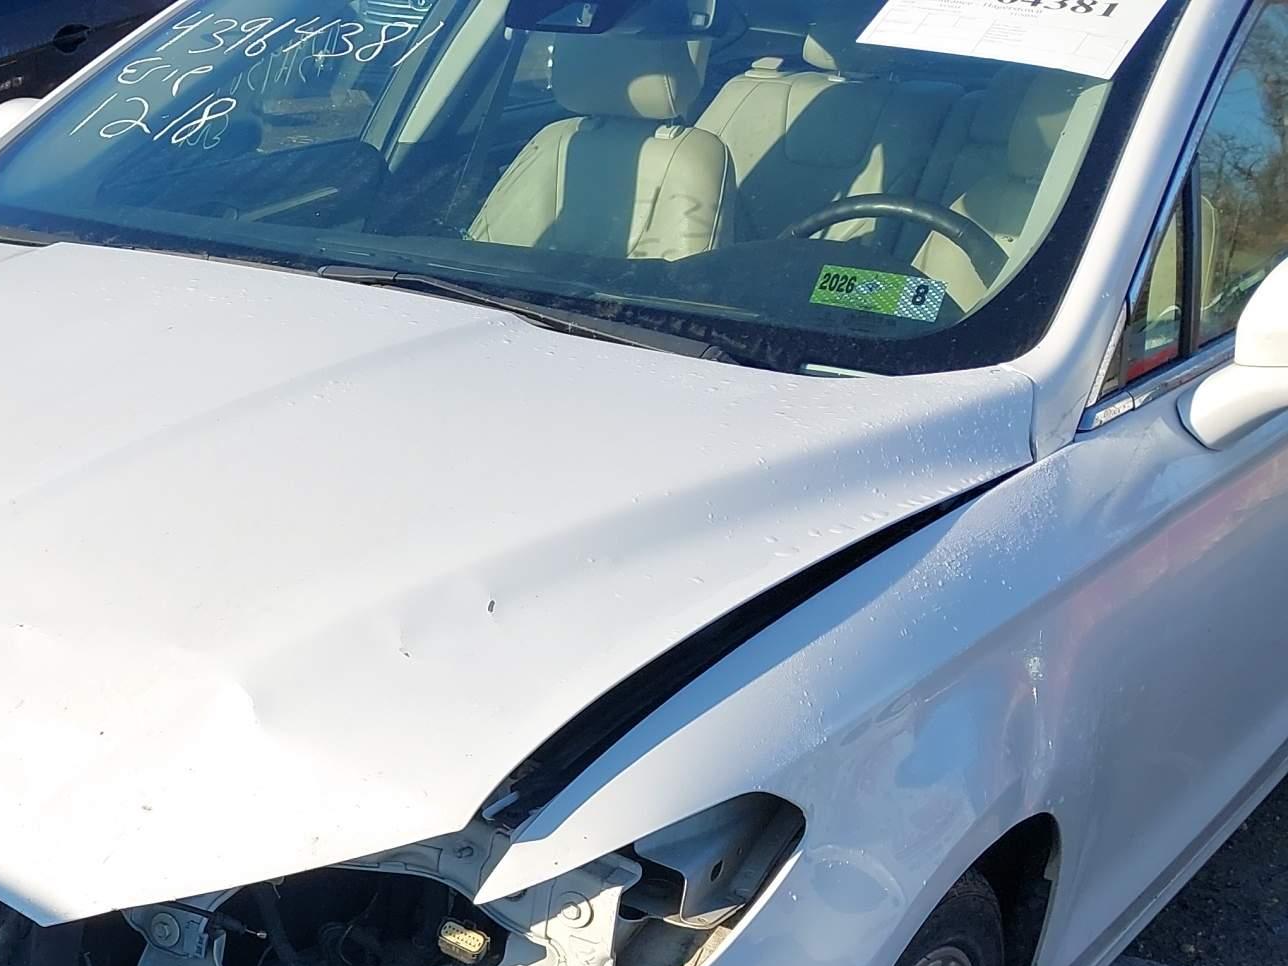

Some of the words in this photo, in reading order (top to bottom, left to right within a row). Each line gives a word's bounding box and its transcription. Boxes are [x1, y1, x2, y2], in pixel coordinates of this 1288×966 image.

[156, 11, 445, 67] 43964381
[818, 273, 858, 294] 2026
[912, 284, 929, 306] 8
